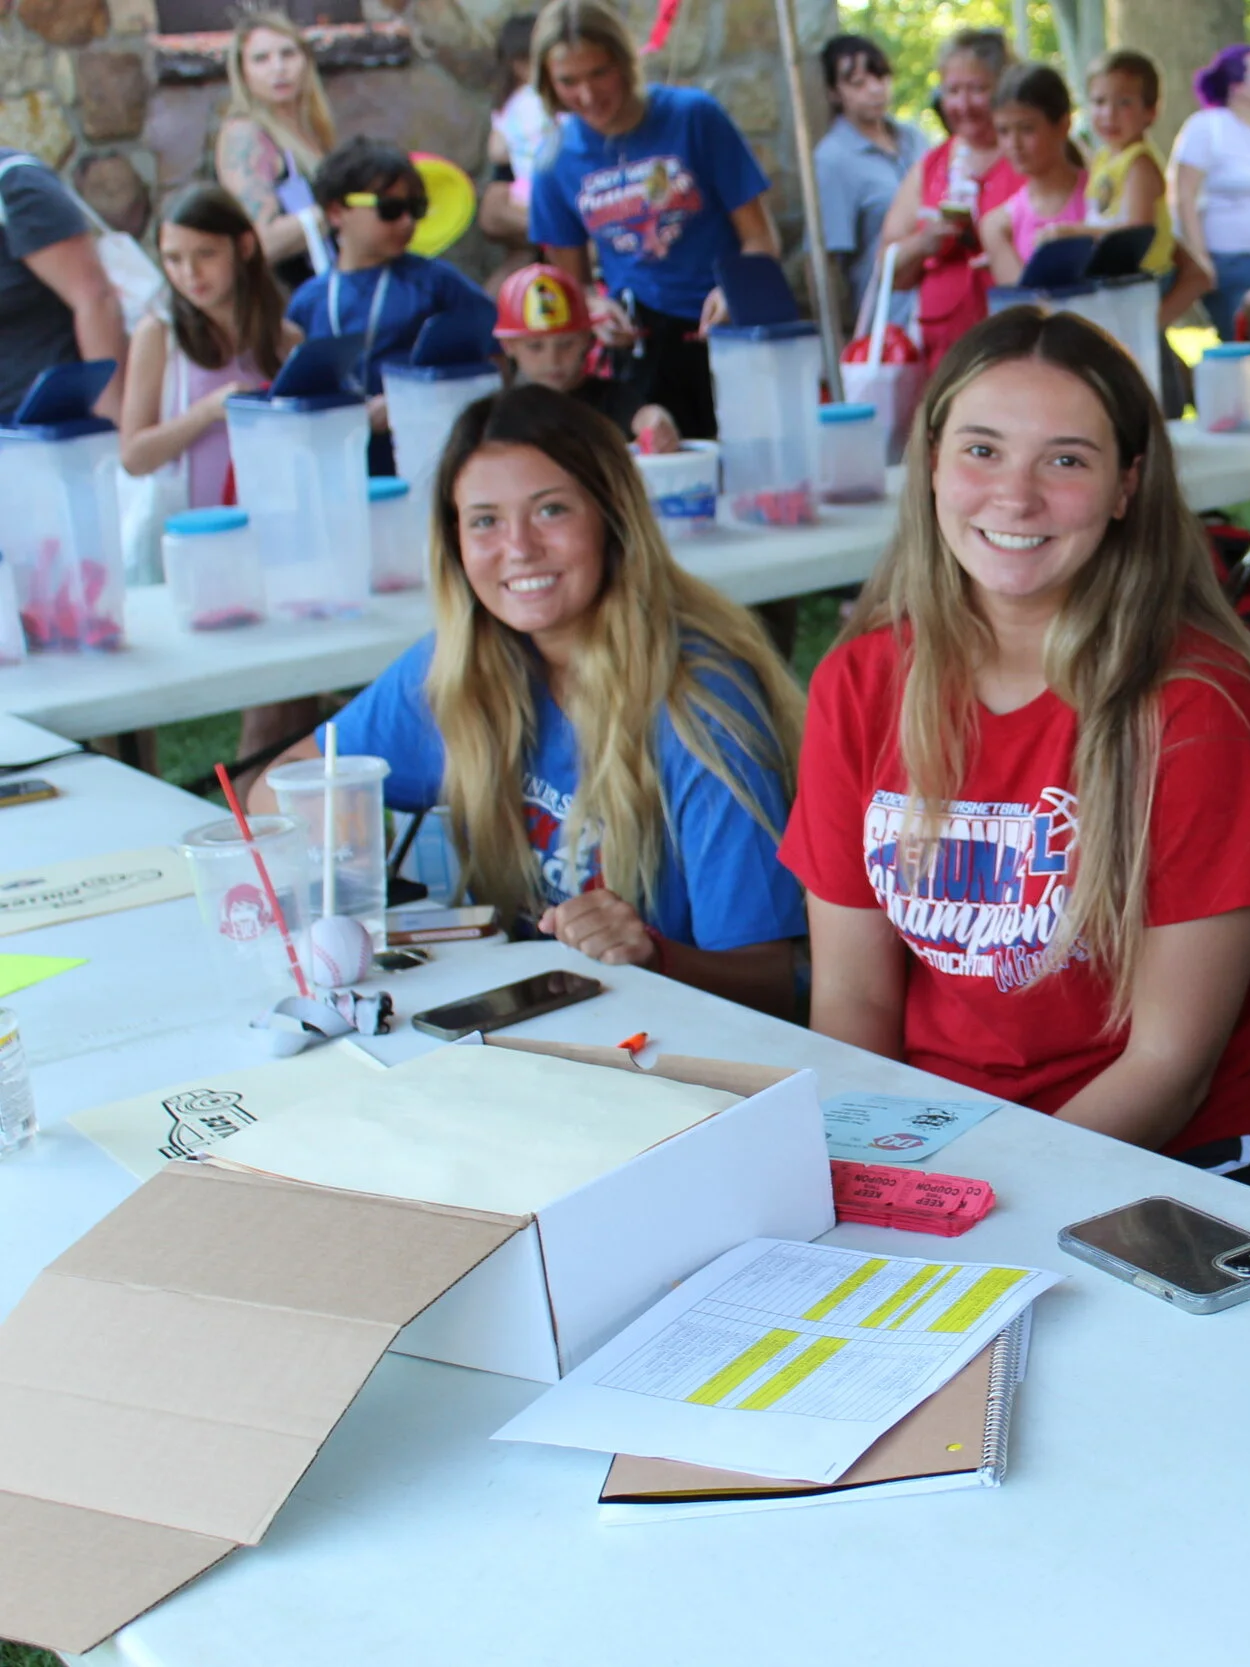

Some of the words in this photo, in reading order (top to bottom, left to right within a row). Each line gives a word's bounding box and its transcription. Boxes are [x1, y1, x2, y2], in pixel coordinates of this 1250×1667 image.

[853, 1173, 897, 1187] COUPON
[853, 1189, 883, 1199] KEEP
[915, 1182, 960, 1196] COUPON
[915, 1198, 945, 1208] KEEP
